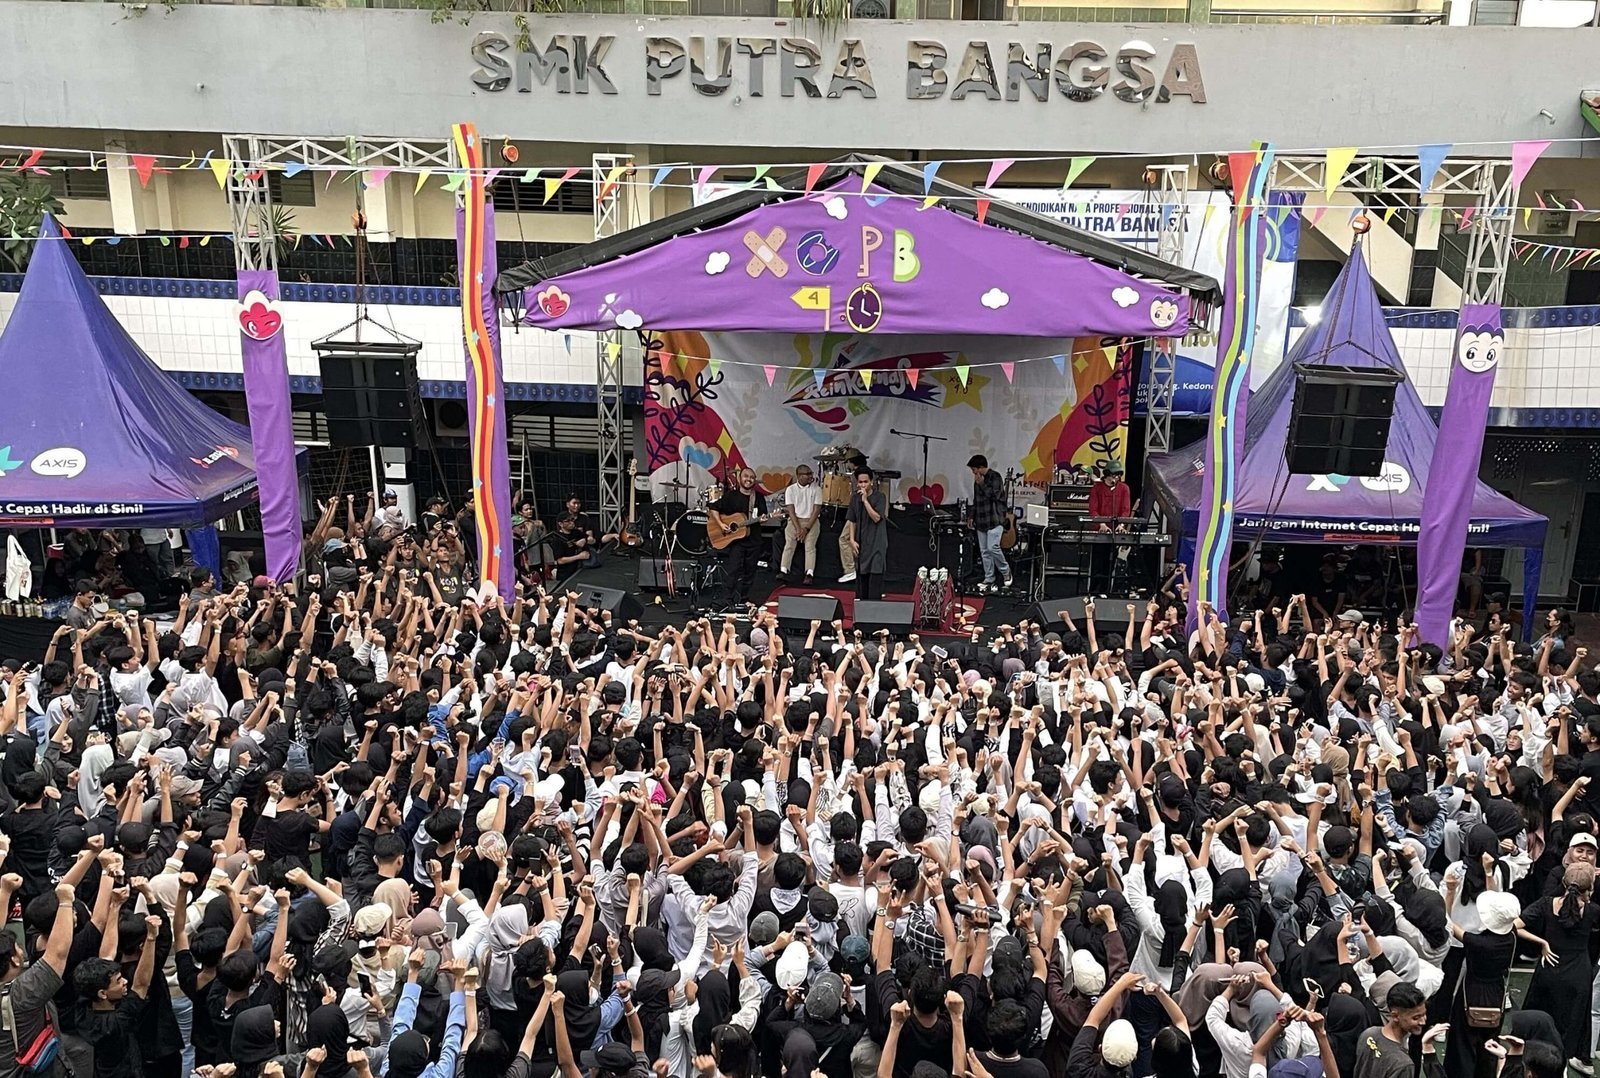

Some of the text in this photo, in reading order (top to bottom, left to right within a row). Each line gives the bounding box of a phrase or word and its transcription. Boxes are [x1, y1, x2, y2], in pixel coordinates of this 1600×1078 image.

[470, 30, 1208, 104] SMK PUTRA BANGSA
[40, 459, 78, 468] AXIS
[1367, 473, 1403, 483] AXIS
[6, 504, 49, 516] Cepat
[52, 503, 91, 515] Hadir
[94, 504, 109, 514] di
[111, 504, 143, 514] Sini!
[1239, 518, 1298, 530] Jaringan
[1301, 520, 1356, 530] Internet
[1358, 521, 1399, 533] Cepat
[1468, 524, 1490, 533] ini!
